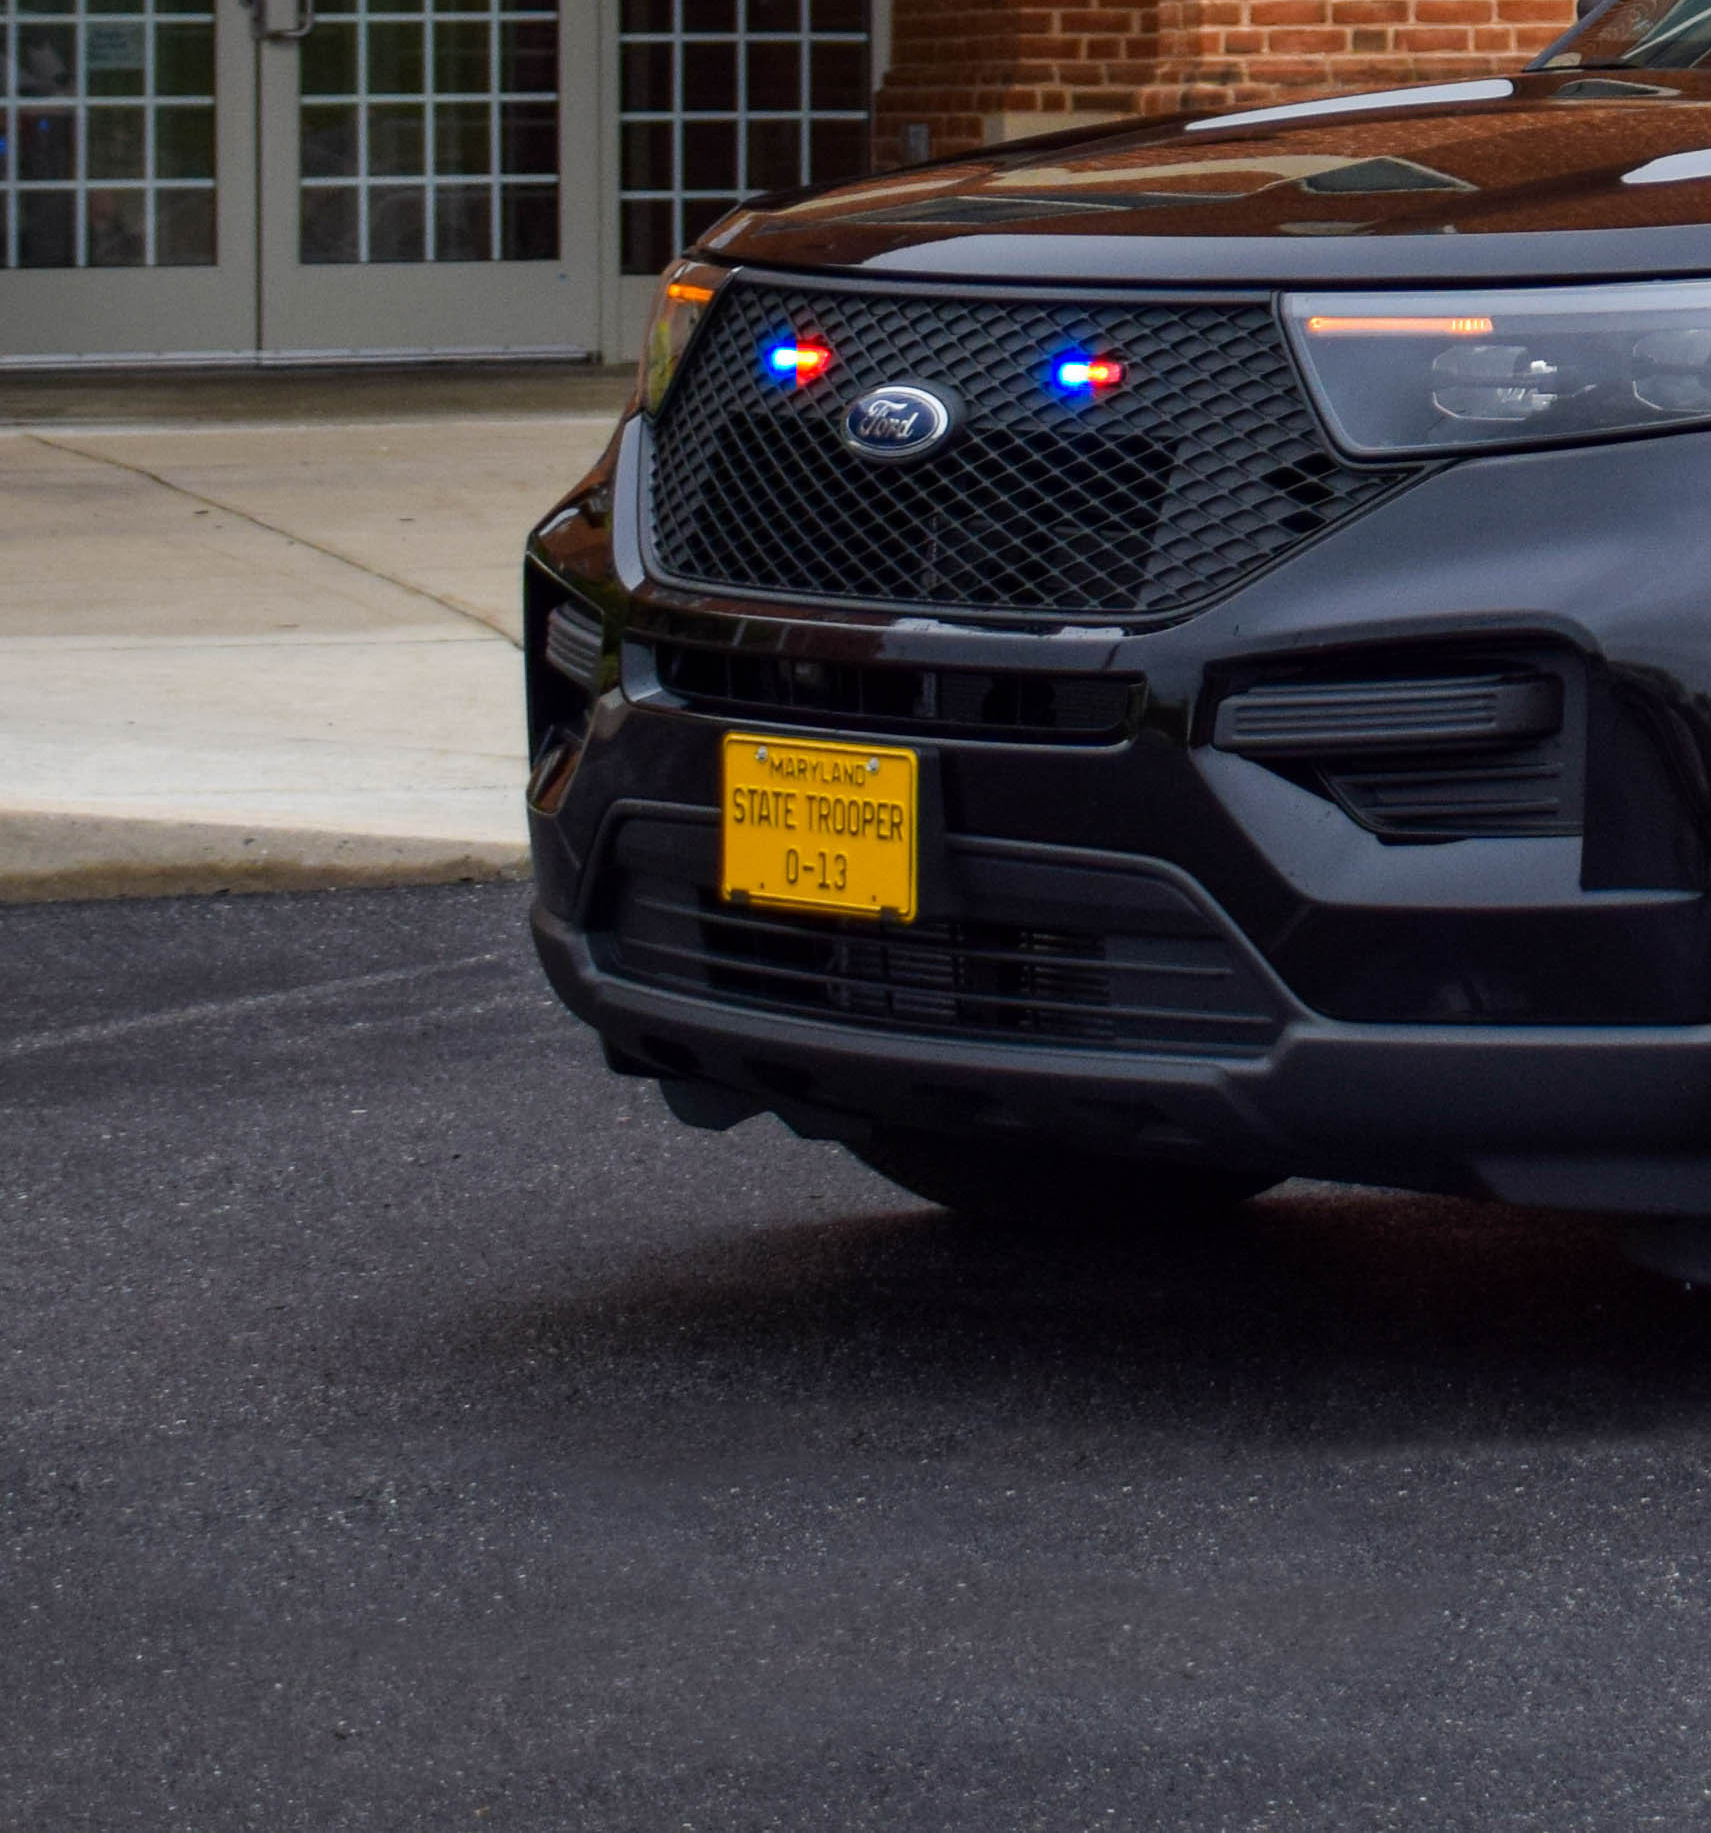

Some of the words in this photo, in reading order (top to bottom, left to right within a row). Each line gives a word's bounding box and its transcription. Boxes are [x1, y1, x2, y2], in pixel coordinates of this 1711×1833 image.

[860, 399, 919, 438] Ford
[769, 754, 866, 787] MARYLAND
[732, 787, 796, 831] STATE
[805, 794, 904, 842] TROOPER
